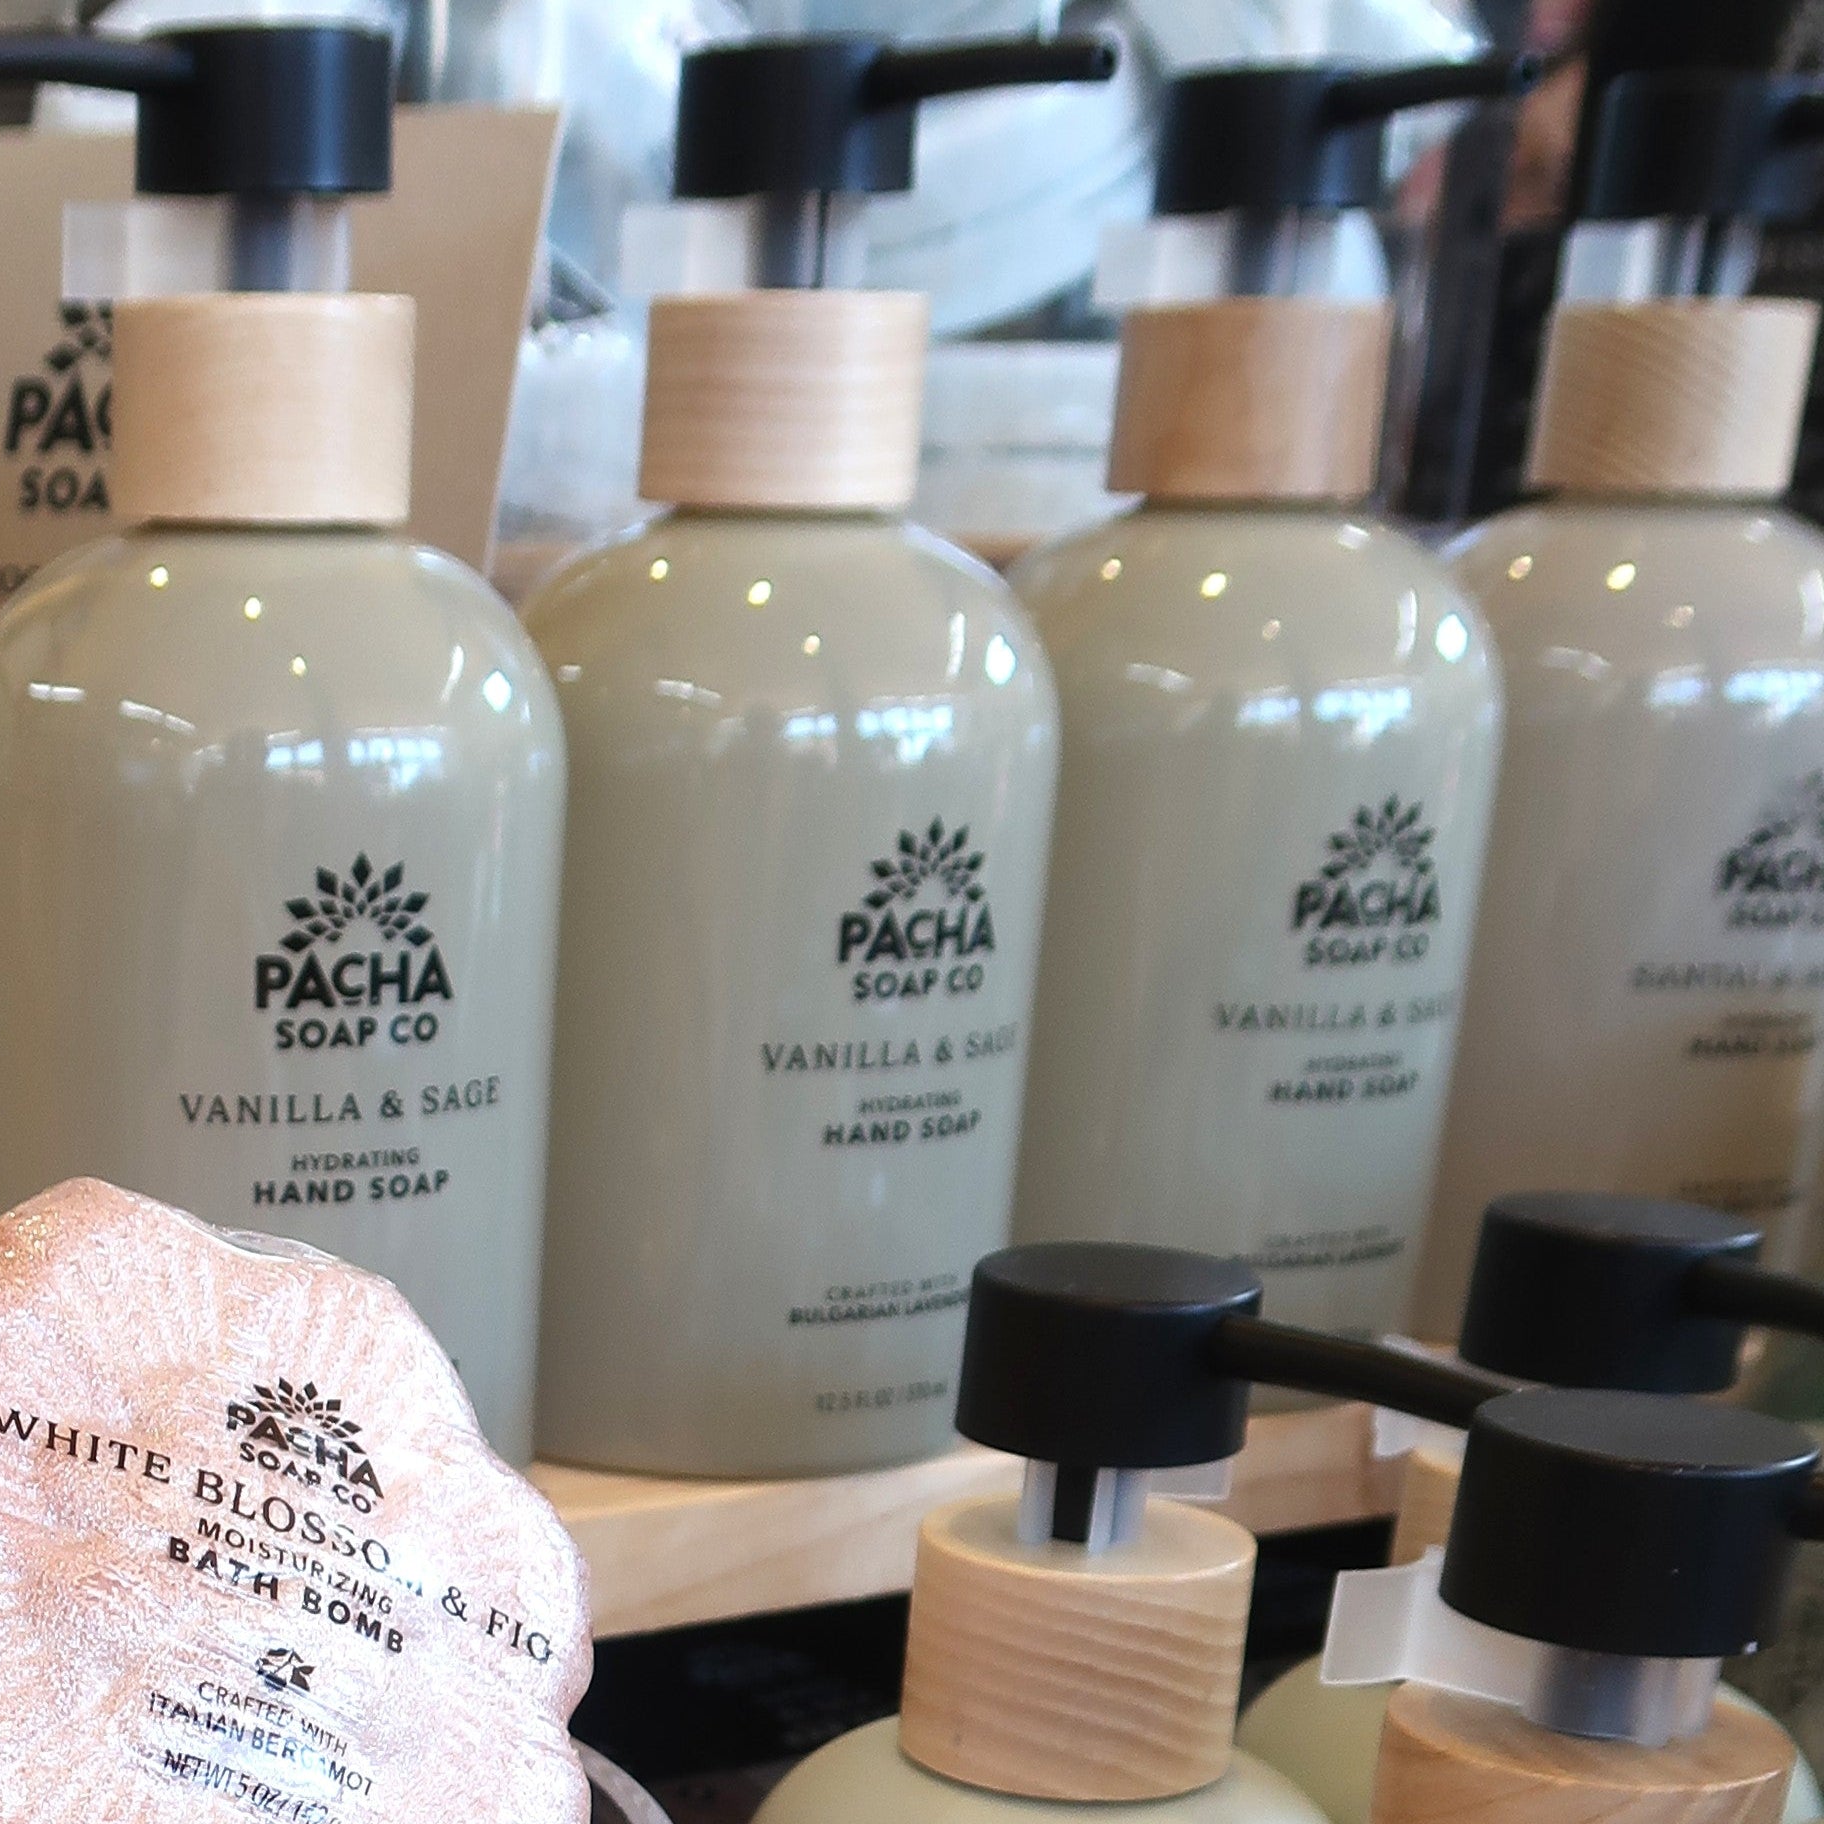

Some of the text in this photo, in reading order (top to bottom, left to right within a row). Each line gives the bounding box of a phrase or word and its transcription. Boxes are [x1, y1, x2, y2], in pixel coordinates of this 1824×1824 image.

[20, 467, 109, 513] SOA
[1291, 879, 1442, 931] PACHA
[838, 901, 995, 962] PACHA
[1306, 937, 1387, 965] SOAP
[255, 944, 454, 1009] PACHA
[854, 962, 984, 1002] SOAP CO
[276, 1012, 440, 1050] SOAP CO
[1215, 1002, 1365, 1031] VANILLA
[761, 1038, 921, 1073] VANILLA
[933, 1036, 954, 1063] &
[179, 1075, 501, 1126] VANILLA & SAGE
[1270, 1070, 1419, 1102] HAND SOAP
[824, 1107, 983, 1144] HAND SOAP
[291, 1146, 421, 1172] HYDRATING
[254, 1168, 450, 1205] HAND SOAP
[227, 1400, 384, 1499] PACHA
[239, 1441, 373, 1515] SOAP CO
[195, 1467, 424, 1598] BLOSSO
[441, 1585, 468, 1622] &
[485, 1606, 553, 1665] FIG
[197, 1517, 393, 1615] MOISTURIZING
[169, 1536, 404, 1654] BATH BOMB
[198, 1680, 348, 1757] CRAFTED WITH
[149, 1692, 374, 1796] ITALIAN BERGAMOT
[164, 1749, 206, 1780] NET
[204, 1760, 237, 1793] WT
[234, 1773, 251, 1799] 5
